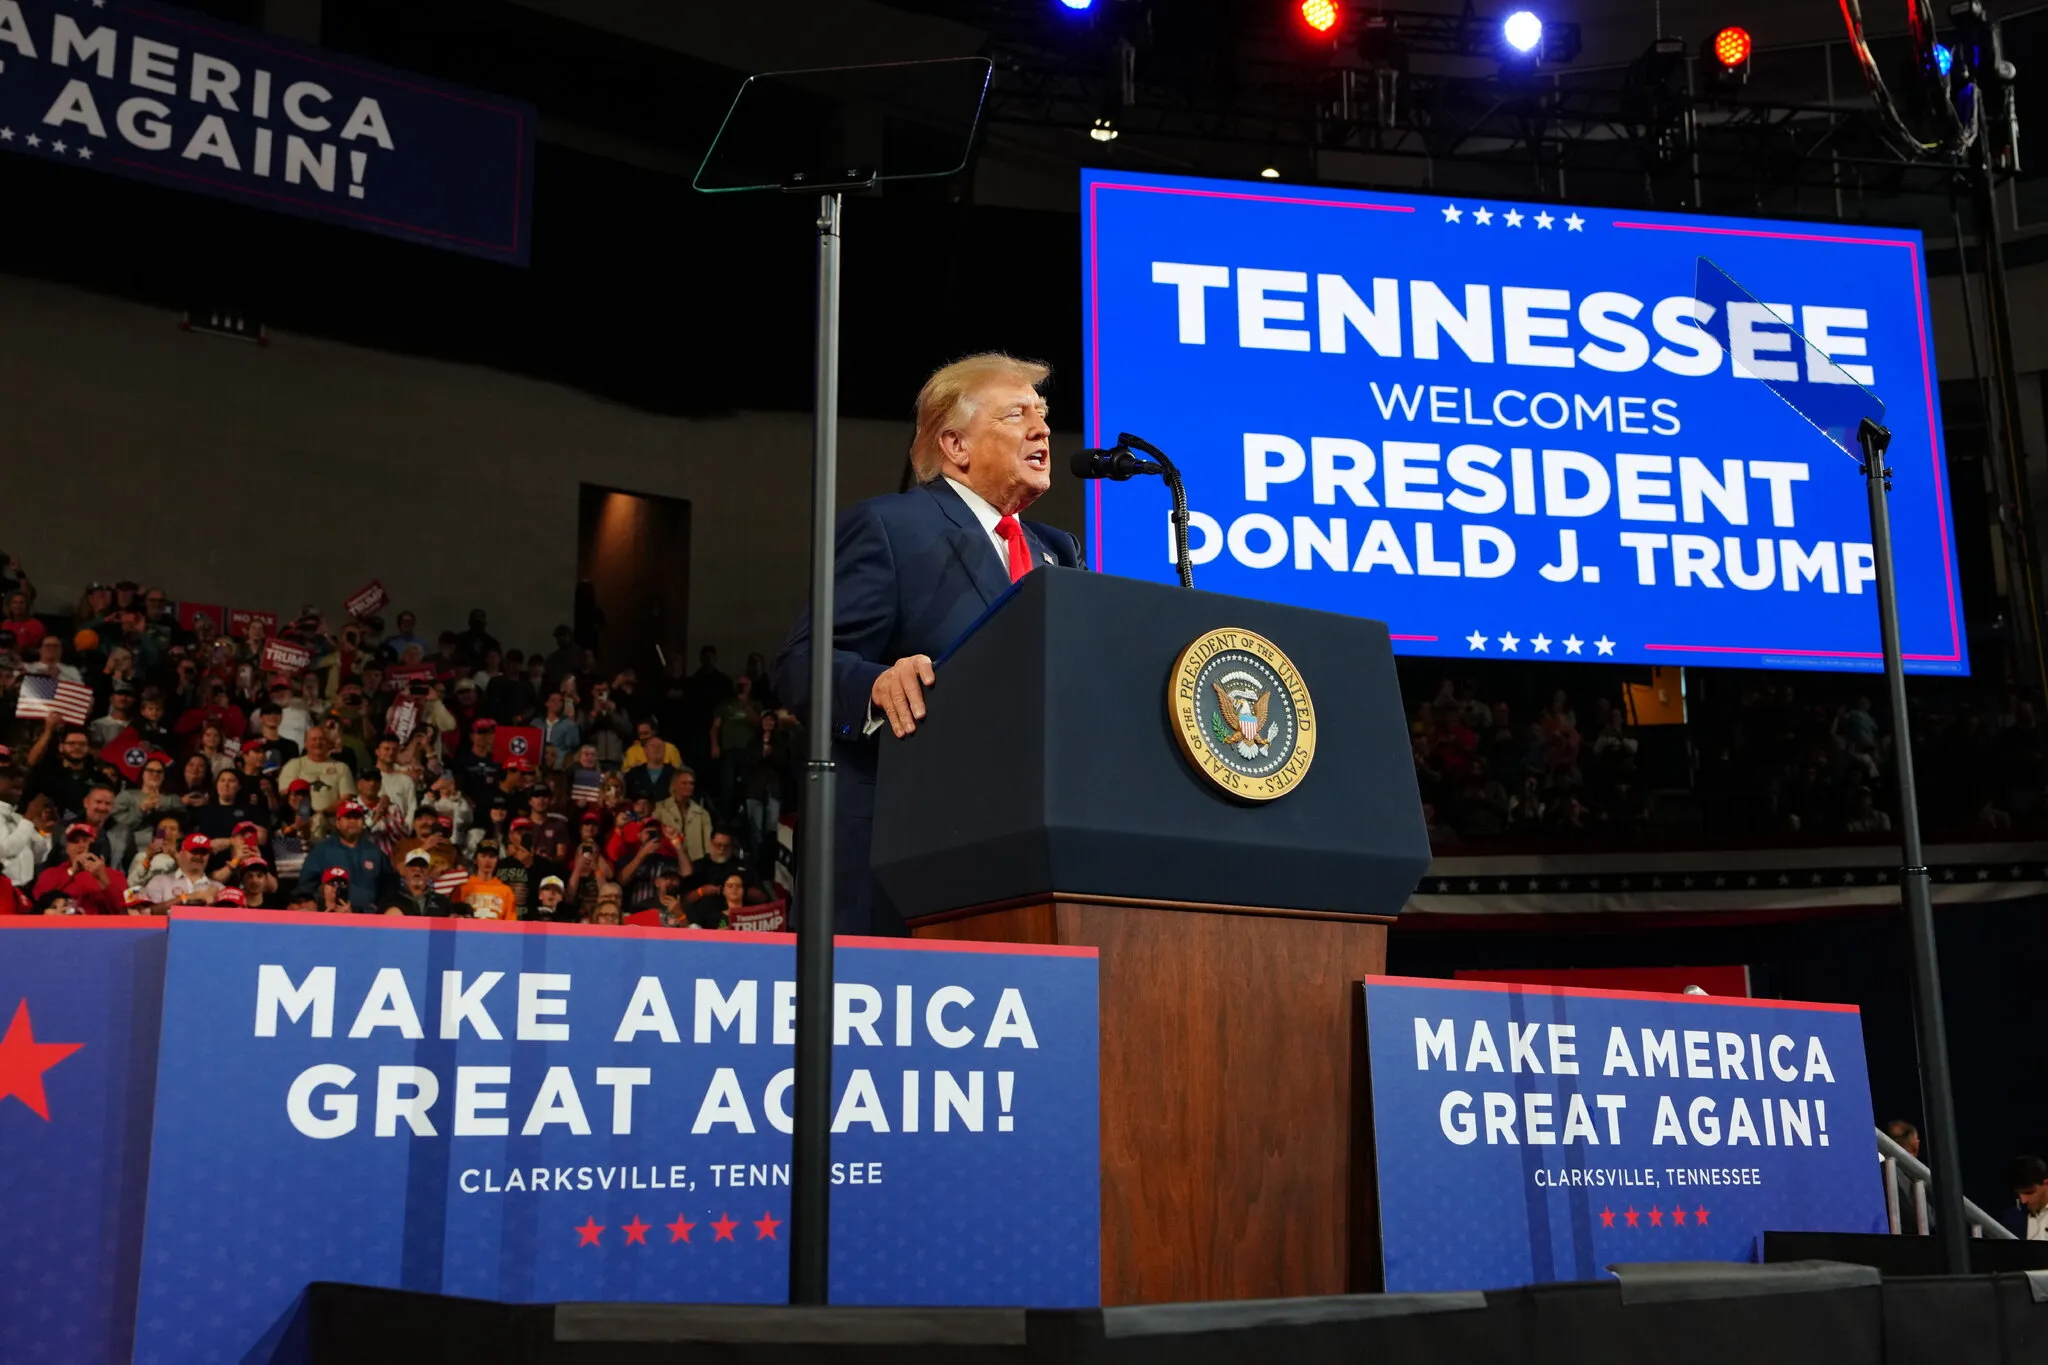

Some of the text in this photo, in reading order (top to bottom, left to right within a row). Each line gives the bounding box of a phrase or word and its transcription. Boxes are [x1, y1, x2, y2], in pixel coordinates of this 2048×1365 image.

[0, 0, 394, 150] AMERICA
[42, 79, 368, 199] AGAIN!
[1151, 261, 1875, 386] TENNESSEE
[1369, 382, 1682, 437] WELCOMES
[1243, 432, 1811, 529] PRESIDENT
[1167, 506, 1878, 595] DONALD J. TRUMP
[266, 647, 310, 668] TRUMP
[1180, 633, 1311, 793] SEAL OF THE PRESIDENT OF THE UNITED STATES
[732, 915, 784, 932] TRUMP
[254, 963, 1040, 1049] MAKE AMERICA
[1413, 1016, 1836, 1084] MAKE AMERICA
[286, 1063, 653, 1140] GREAT
[1439, 1089, 1832, 1148] GREAT AGAIN!
[459, 1161, 884, 1194] CLARKSVILLE, TENNSEE
[1534, 1167, 1763, 1190] CLARKSVILLE, TENNESSEE
